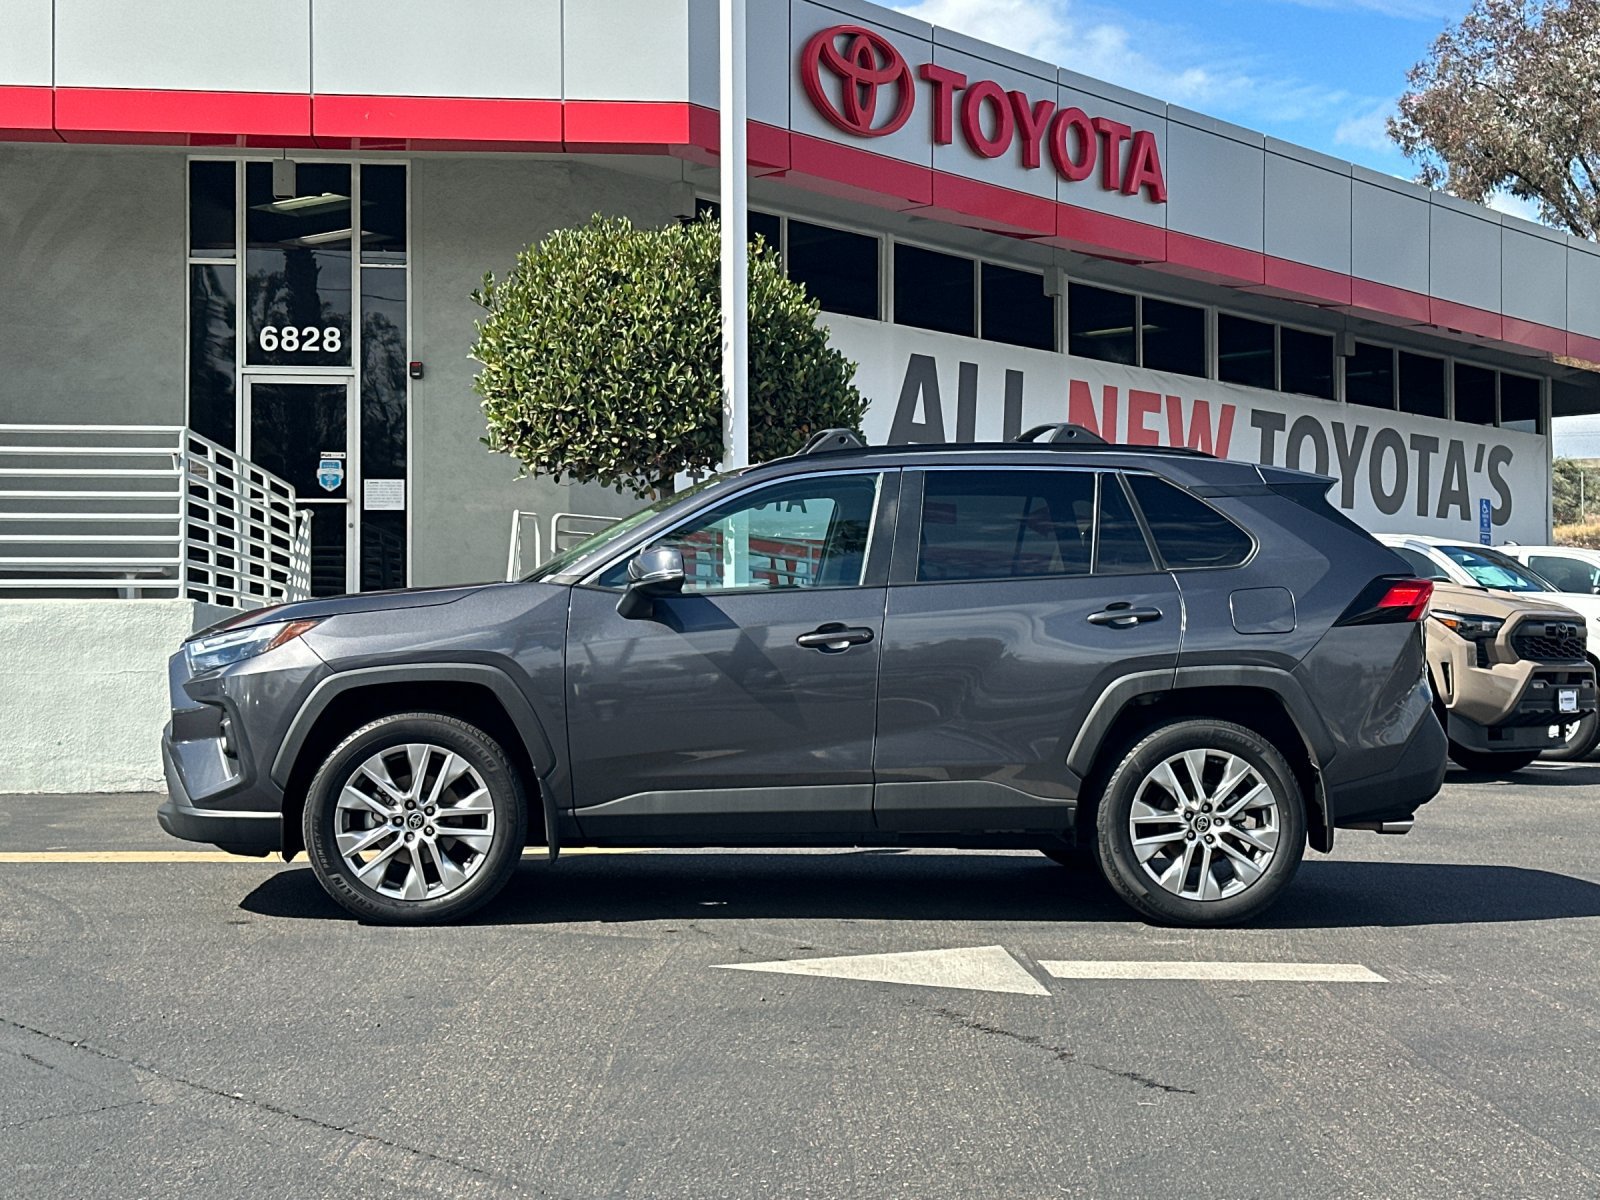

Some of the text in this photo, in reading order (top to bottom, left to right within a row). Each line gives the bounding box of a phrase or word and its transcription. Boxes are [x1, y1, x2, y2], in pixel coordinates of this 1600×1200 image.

[919, 63, 1168, 204] TOYOTA
[259, 325, 342, 352] 6828
[1250, 408, 1514, 527] TOYOTA'S
